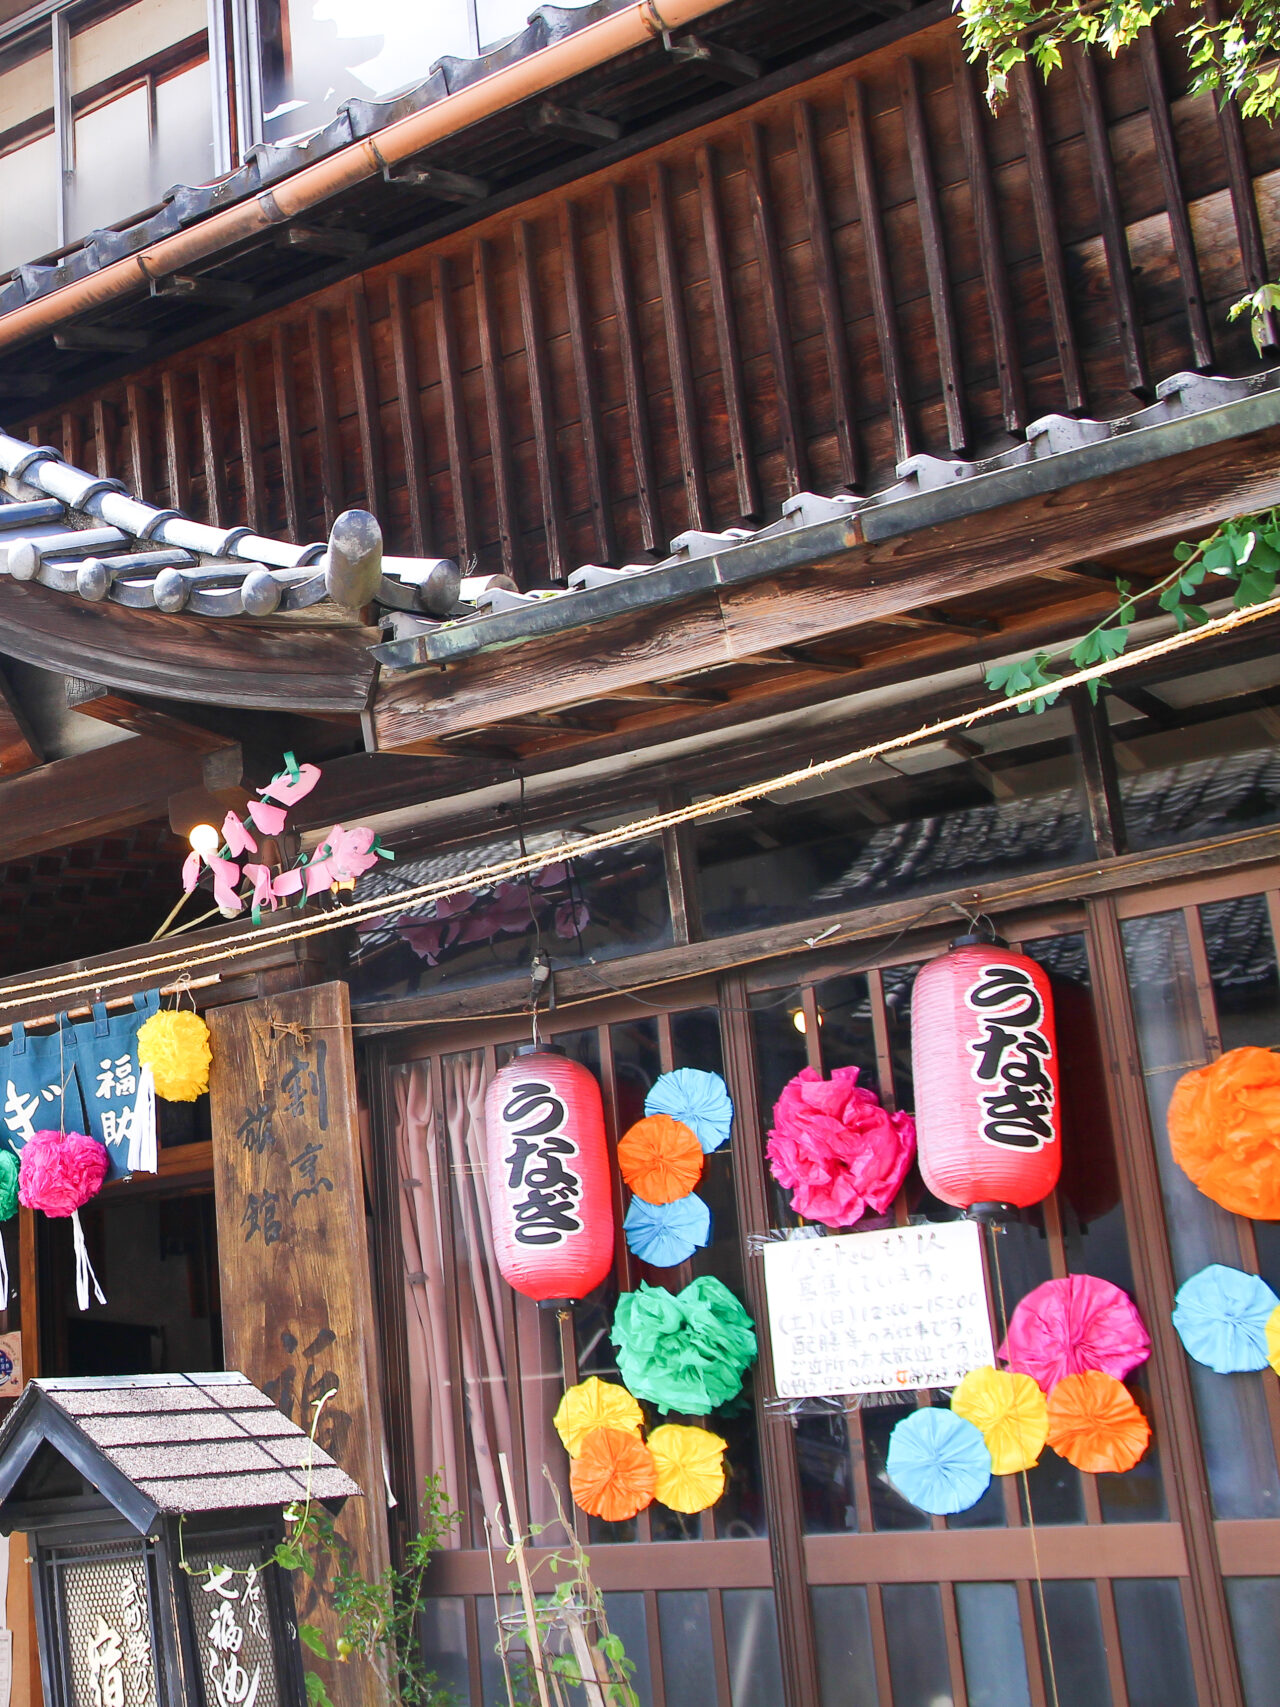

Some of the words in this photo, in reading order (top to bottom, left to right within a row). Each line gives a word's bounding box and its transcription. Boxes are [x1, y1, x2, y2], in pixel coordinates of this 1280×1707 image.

[95, 1053, 136, 1147] 福助
[280, 1039, 334, 1207] 割烹
[963, 962, 1056, 1153] うなぎ
[236, 1104, 280, 1247] 旅館
[502, 1078, 584, 1247] うなぎ
